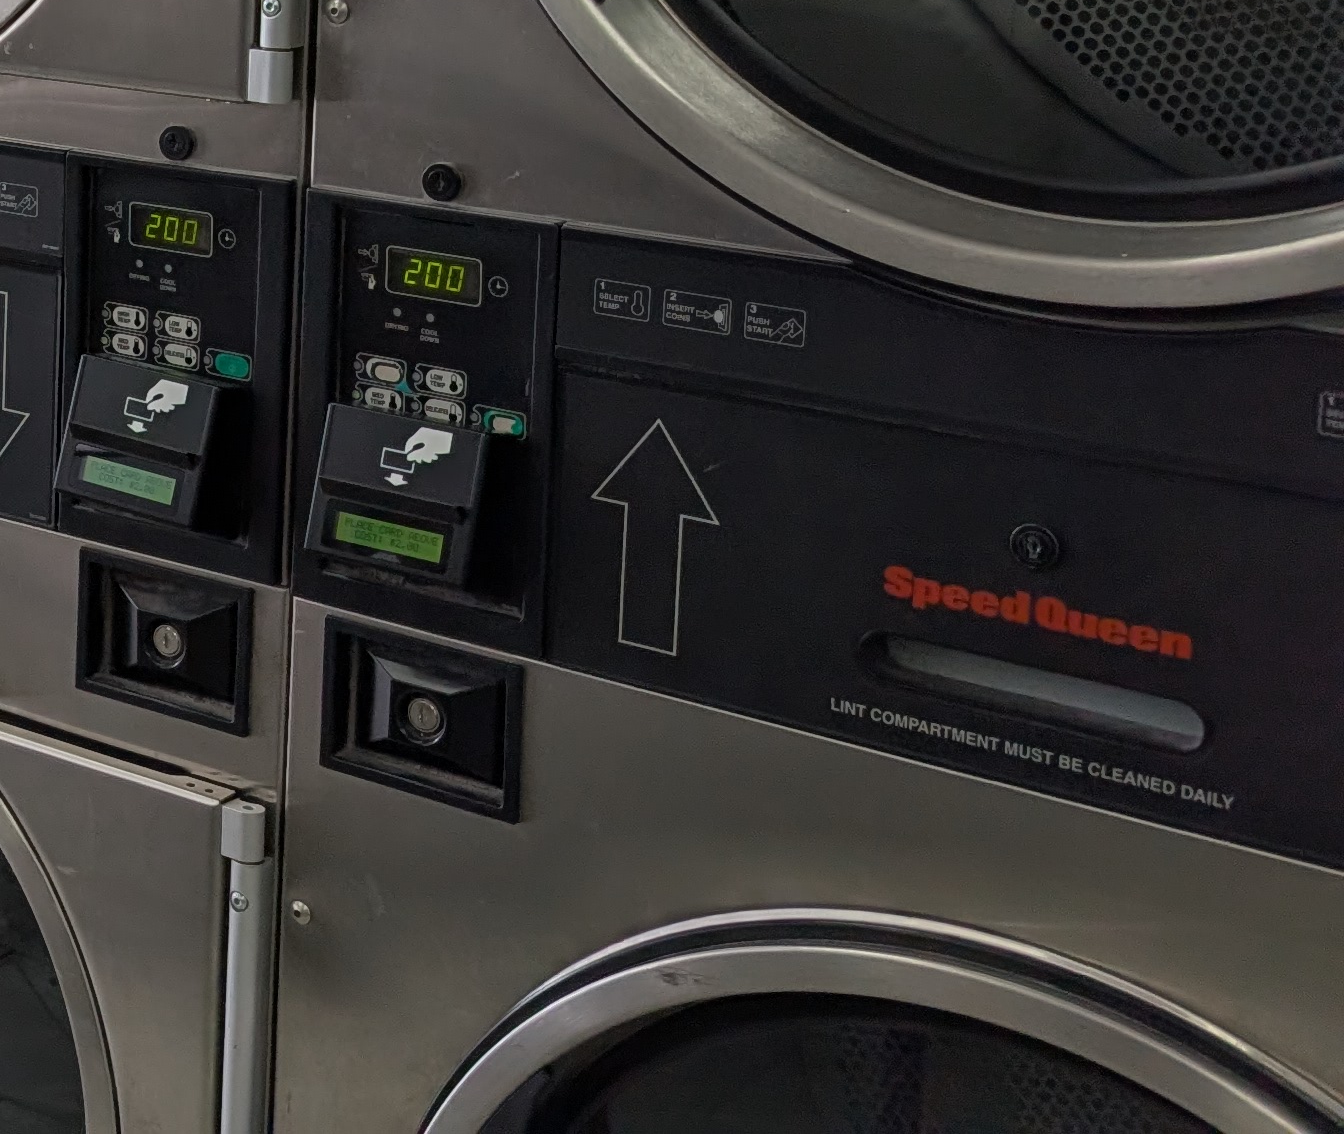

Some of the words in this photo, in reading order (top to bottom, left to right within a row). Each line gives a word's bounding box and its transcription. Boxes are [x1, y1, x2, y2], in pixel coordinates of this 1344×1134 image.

[145, 213, 198, 245] 200
[403, 258, 465, 293] 200
[599, 281, 606, 290] 1
[599, 292, 629, 303] SELECT
[670, 292, 677, 301] 2
[599, 301, 620, 310] TEMP
[666, 303, 696, 315] INSERT
[749, 304, 757, 313] 3
[747, 316, 770, 326] PUSH
[746, 325, 773, 336] START
[430, 373, 443, 381] LOW
[354, 529, 382, 543] COST:
[378, 524, 404, 538] CARD
[883, 564, 1031, 625] Speed
[1034, 595, 1193, 660] Queen
[830, 696, 866, 718] LINT
[870, 707, 1000, 752] COMPARTMENT
[1004, 739, 1055, 765] MUST
[1058, 754, 1084, 773] BE
[1087, 762, 1176, 795] CLEANED
[1180, 784, 1235, 810] DAILY
